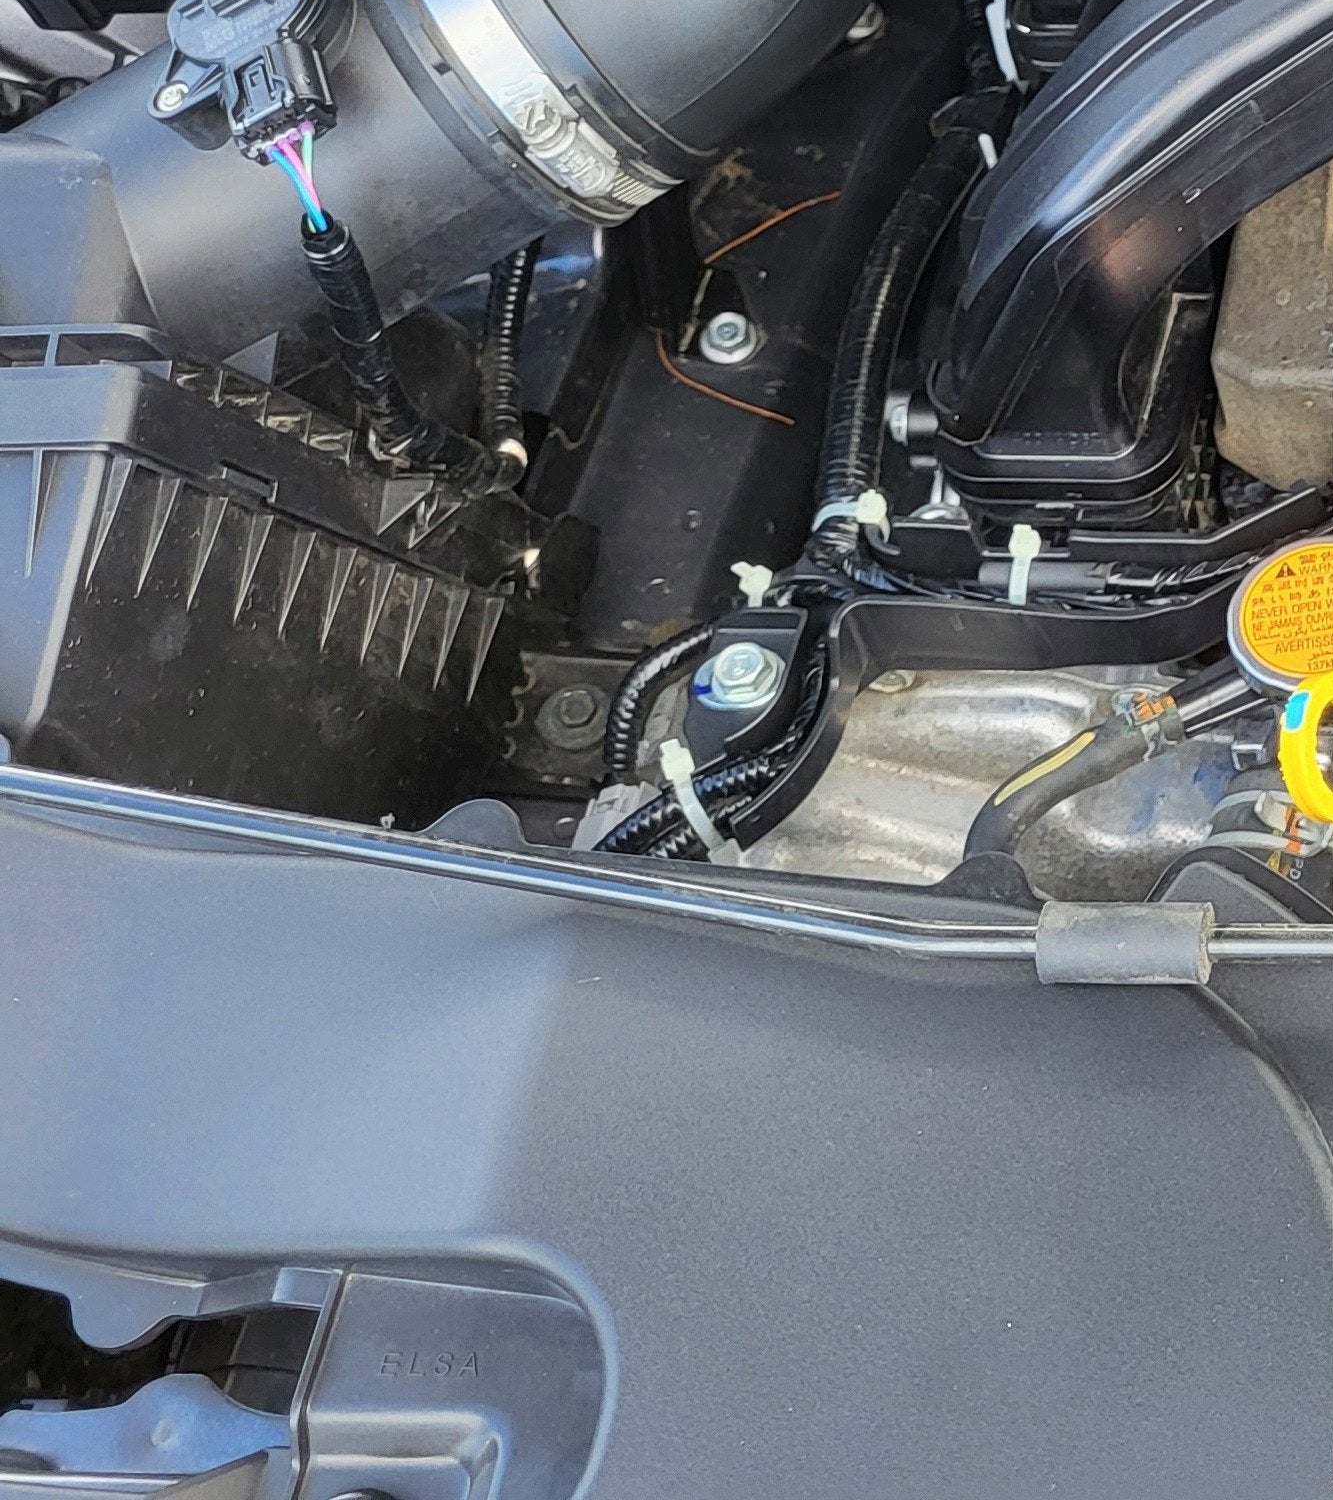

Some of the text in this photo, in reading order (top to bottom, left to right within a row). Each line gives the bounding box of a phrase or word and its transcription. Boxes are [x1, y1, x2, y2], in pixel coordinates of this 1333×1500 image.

[1251, 604, 1288, 621] NEVER
[1292, 599, 1322, 614] OPEN
[1252, 621, 1264, 632] NE
[1267, 616, 1304, 631] JAMAIS
[376, 1351, 479, 1378] ELSA
